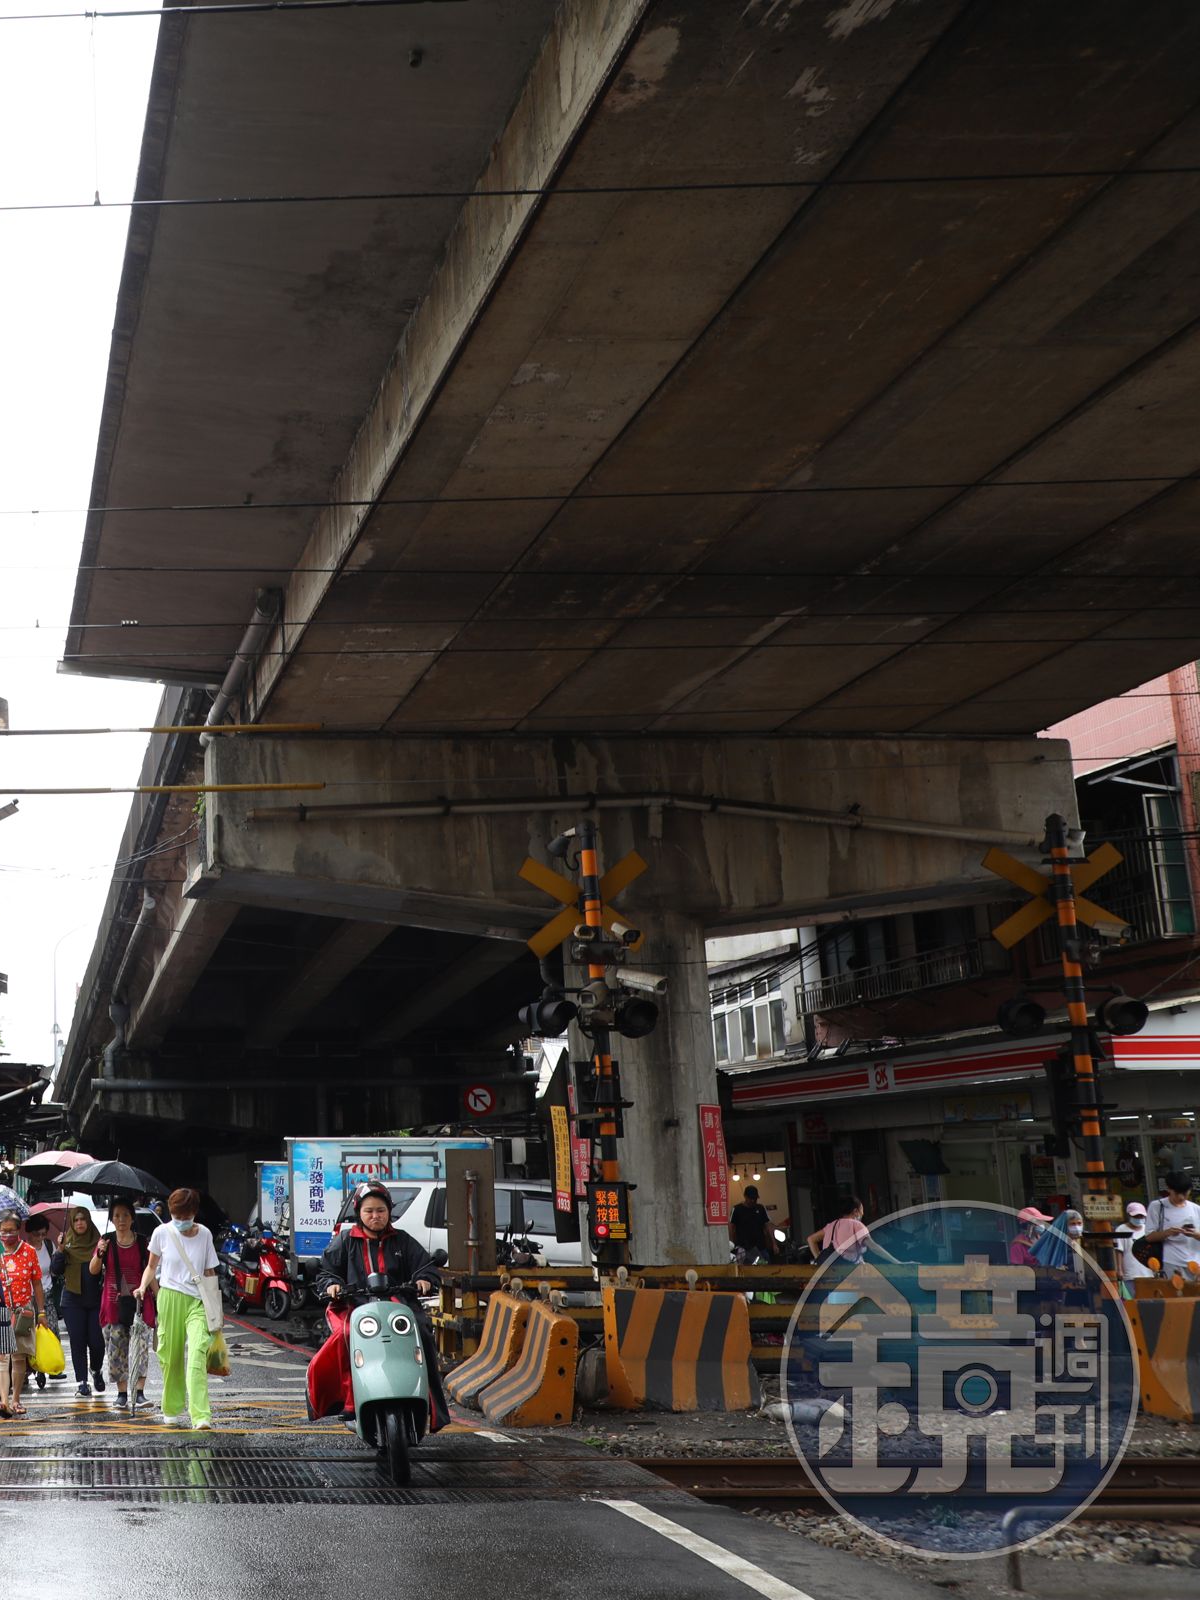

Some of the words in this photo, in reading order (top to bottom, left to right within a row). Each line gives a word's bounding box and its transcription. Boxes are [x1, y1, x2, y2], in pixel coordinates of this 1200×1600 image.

[874, 1065, 889, 1087] OK
[703, 1111, 720, 1217] 請勿逗留
[309, 1156, 325, 1213] 新發商號
[556, 1196, 571, 1212] 1933
[595, 1190, 618, 1206] 緊急
[299, 1218, 336, 1226] 24245311
[596, 1207, 619, 1223] 按鈕
